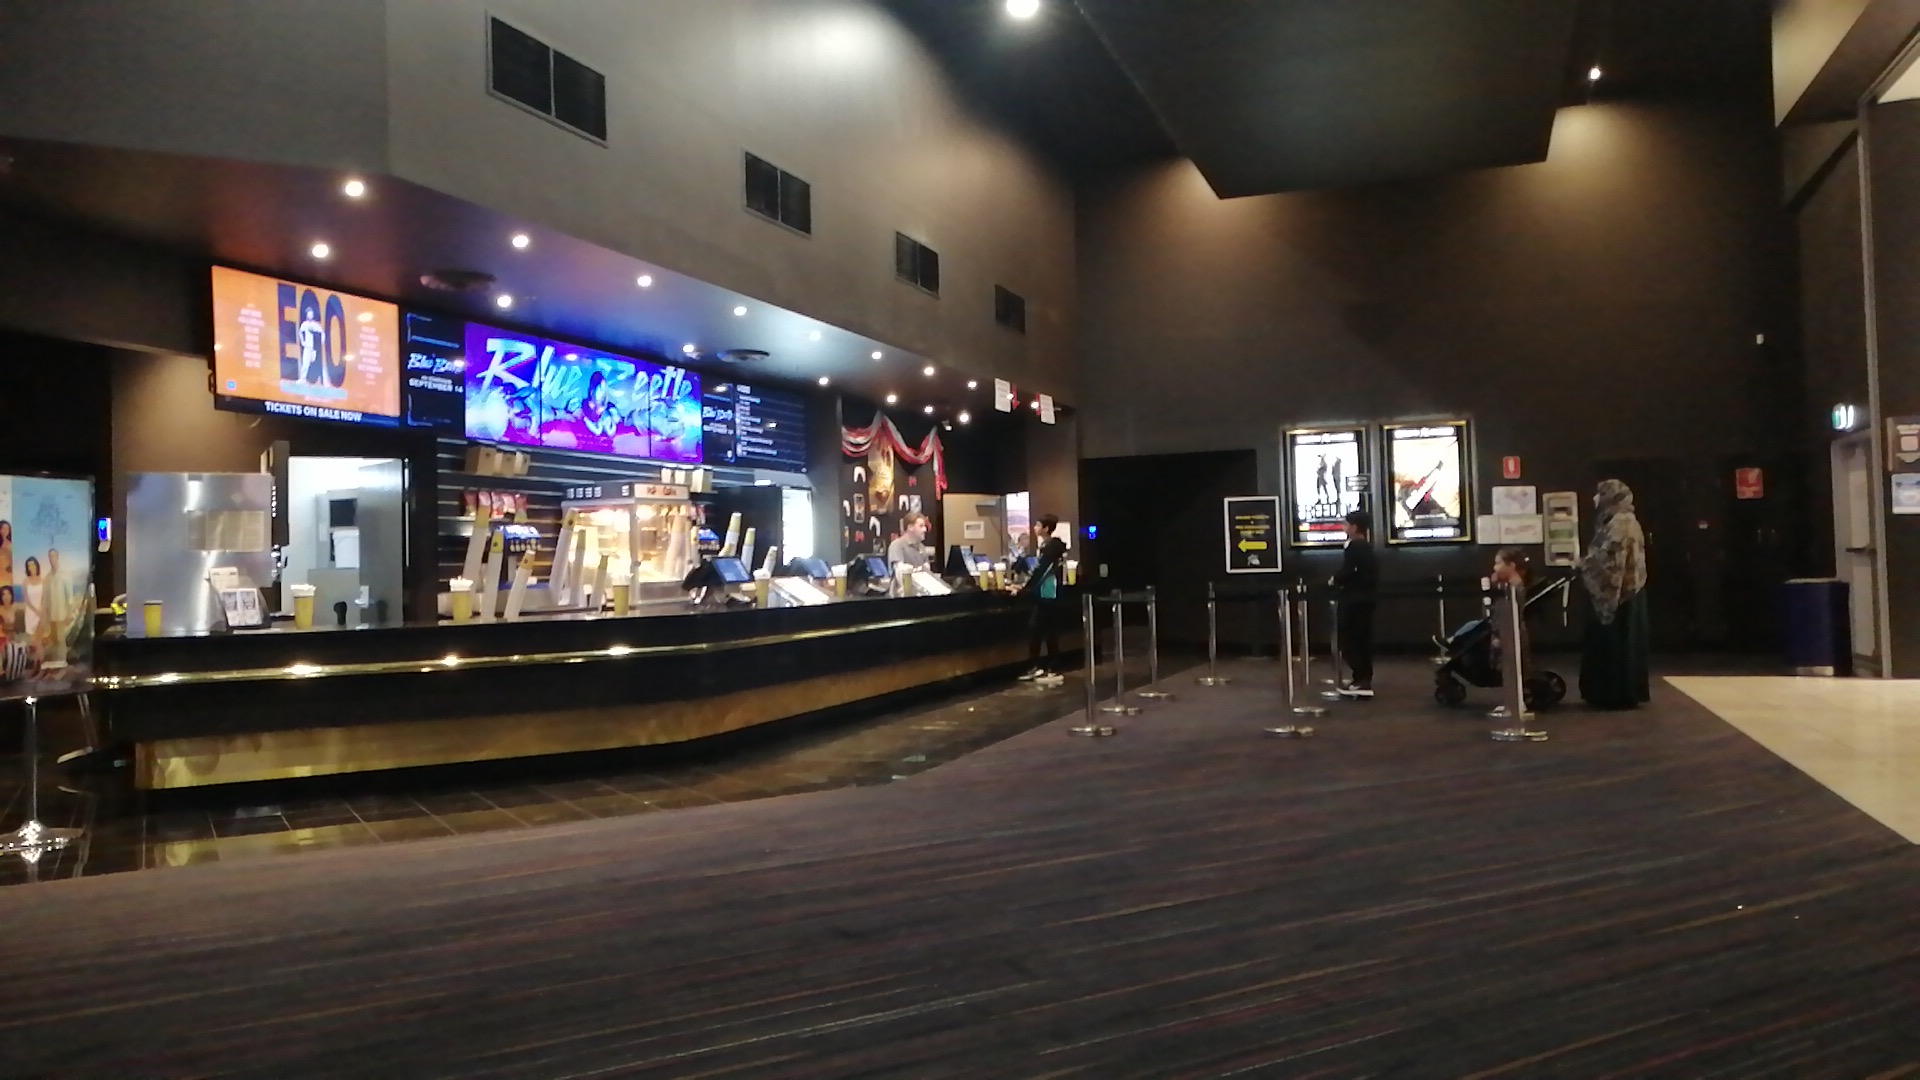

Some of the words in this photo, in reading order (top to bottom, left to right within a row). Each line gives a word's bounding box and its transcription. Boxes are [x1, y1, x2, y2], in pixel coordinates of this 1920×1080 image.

[264, 401, 303, 415] TICKETS
[303, 406, 317, 417] ON
[318, 408, 340, 420] SALE
[340, 411, 363, 422] NOW
